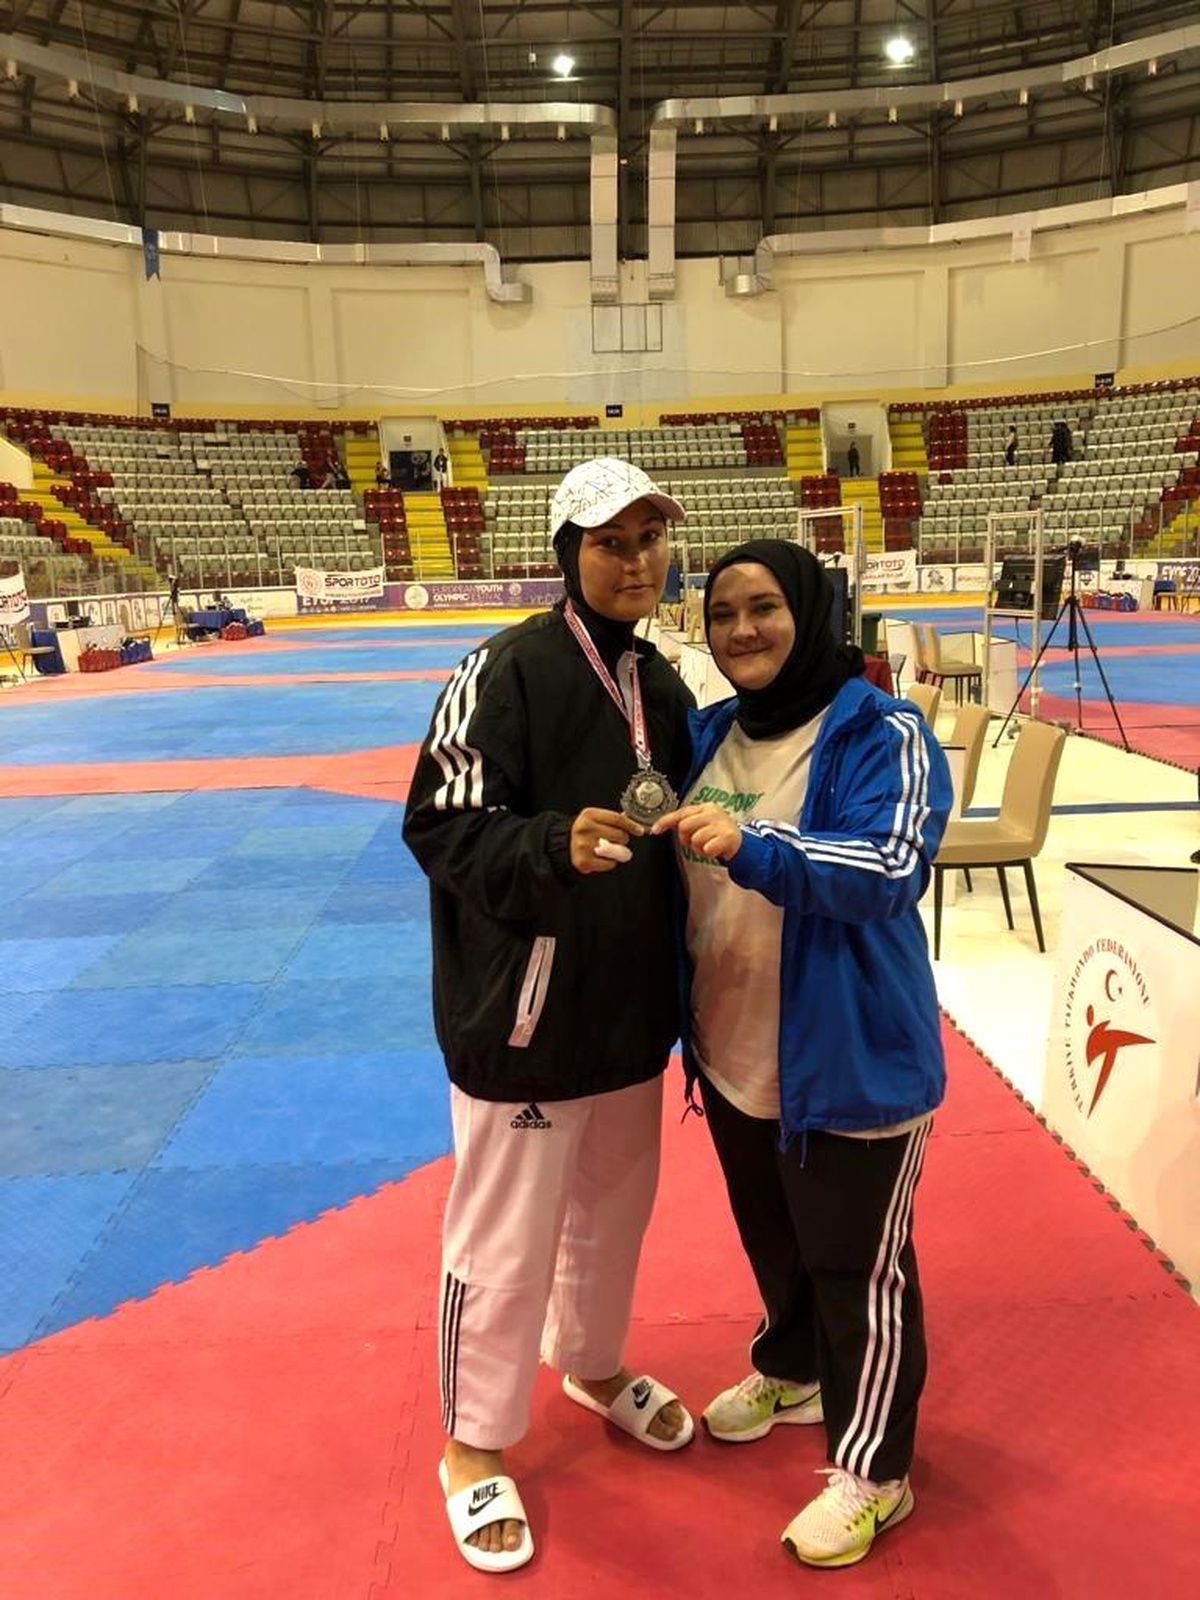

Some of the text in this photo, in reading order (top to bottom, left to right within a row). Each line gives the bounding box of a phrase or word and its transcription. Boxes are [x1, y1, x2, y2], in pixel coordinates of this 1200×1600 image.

[475, 584, 503, 593] YOUTH
[433, 592, 470, 601] OLYMPIC
[510, 1119, 552, 1129] adidas
[473, 1482, 499, 1504] NIKE
